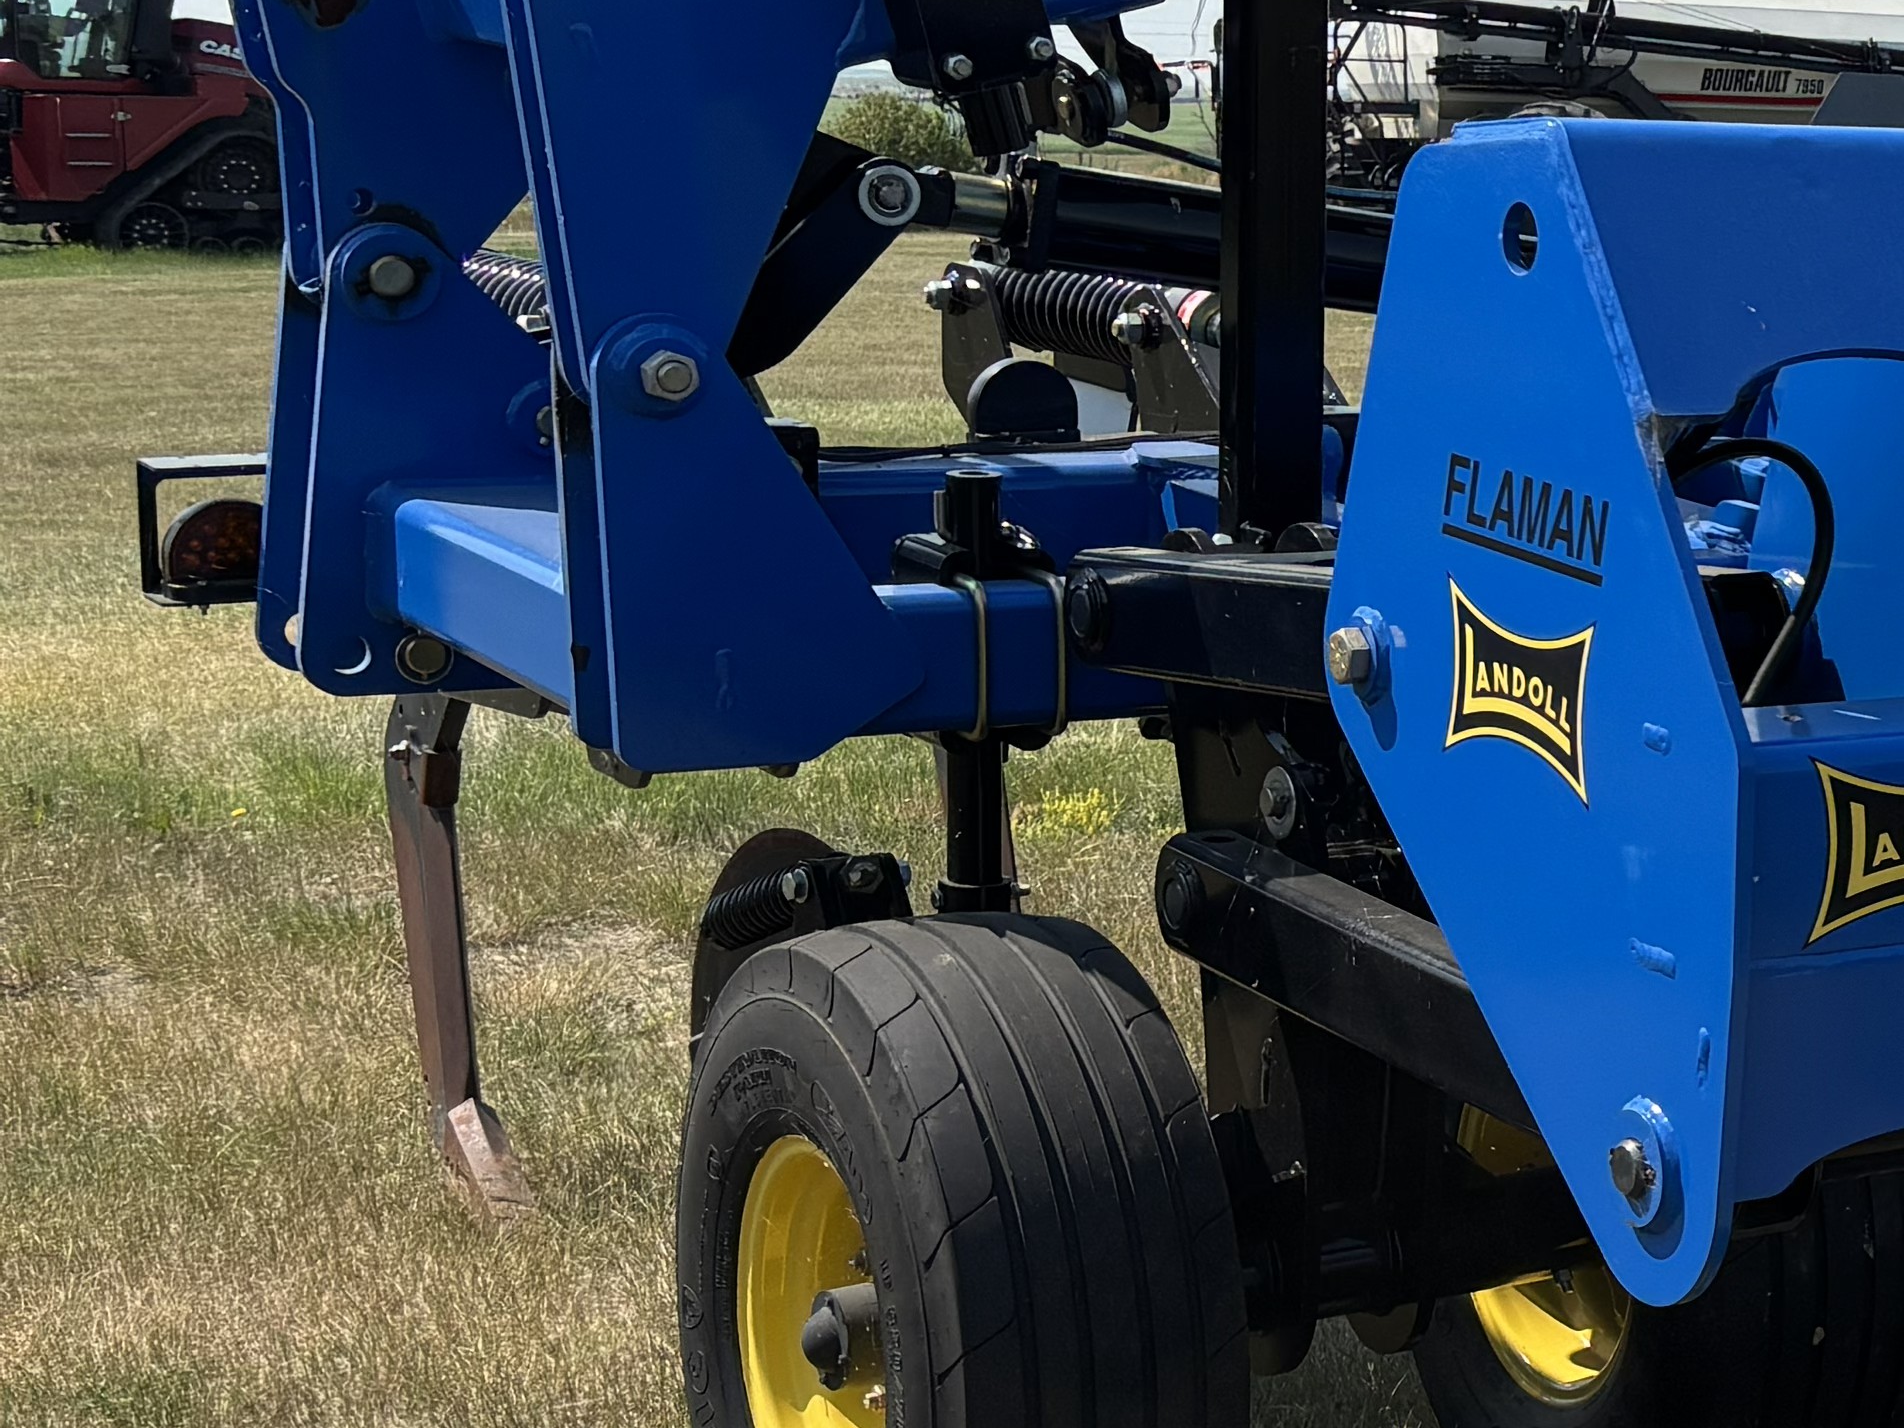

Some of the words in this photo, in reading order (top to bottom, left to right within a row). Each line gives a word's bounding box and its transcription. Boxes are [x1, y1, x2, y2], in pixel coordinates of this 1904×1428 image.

[199, 40, 243, 60] CAS
[1701, 68, 1792, 93] BOURGAULT
[1443, 452, 1609, 567] FLAMAN
[1463, 623, 1571, 756] LANDOLL
